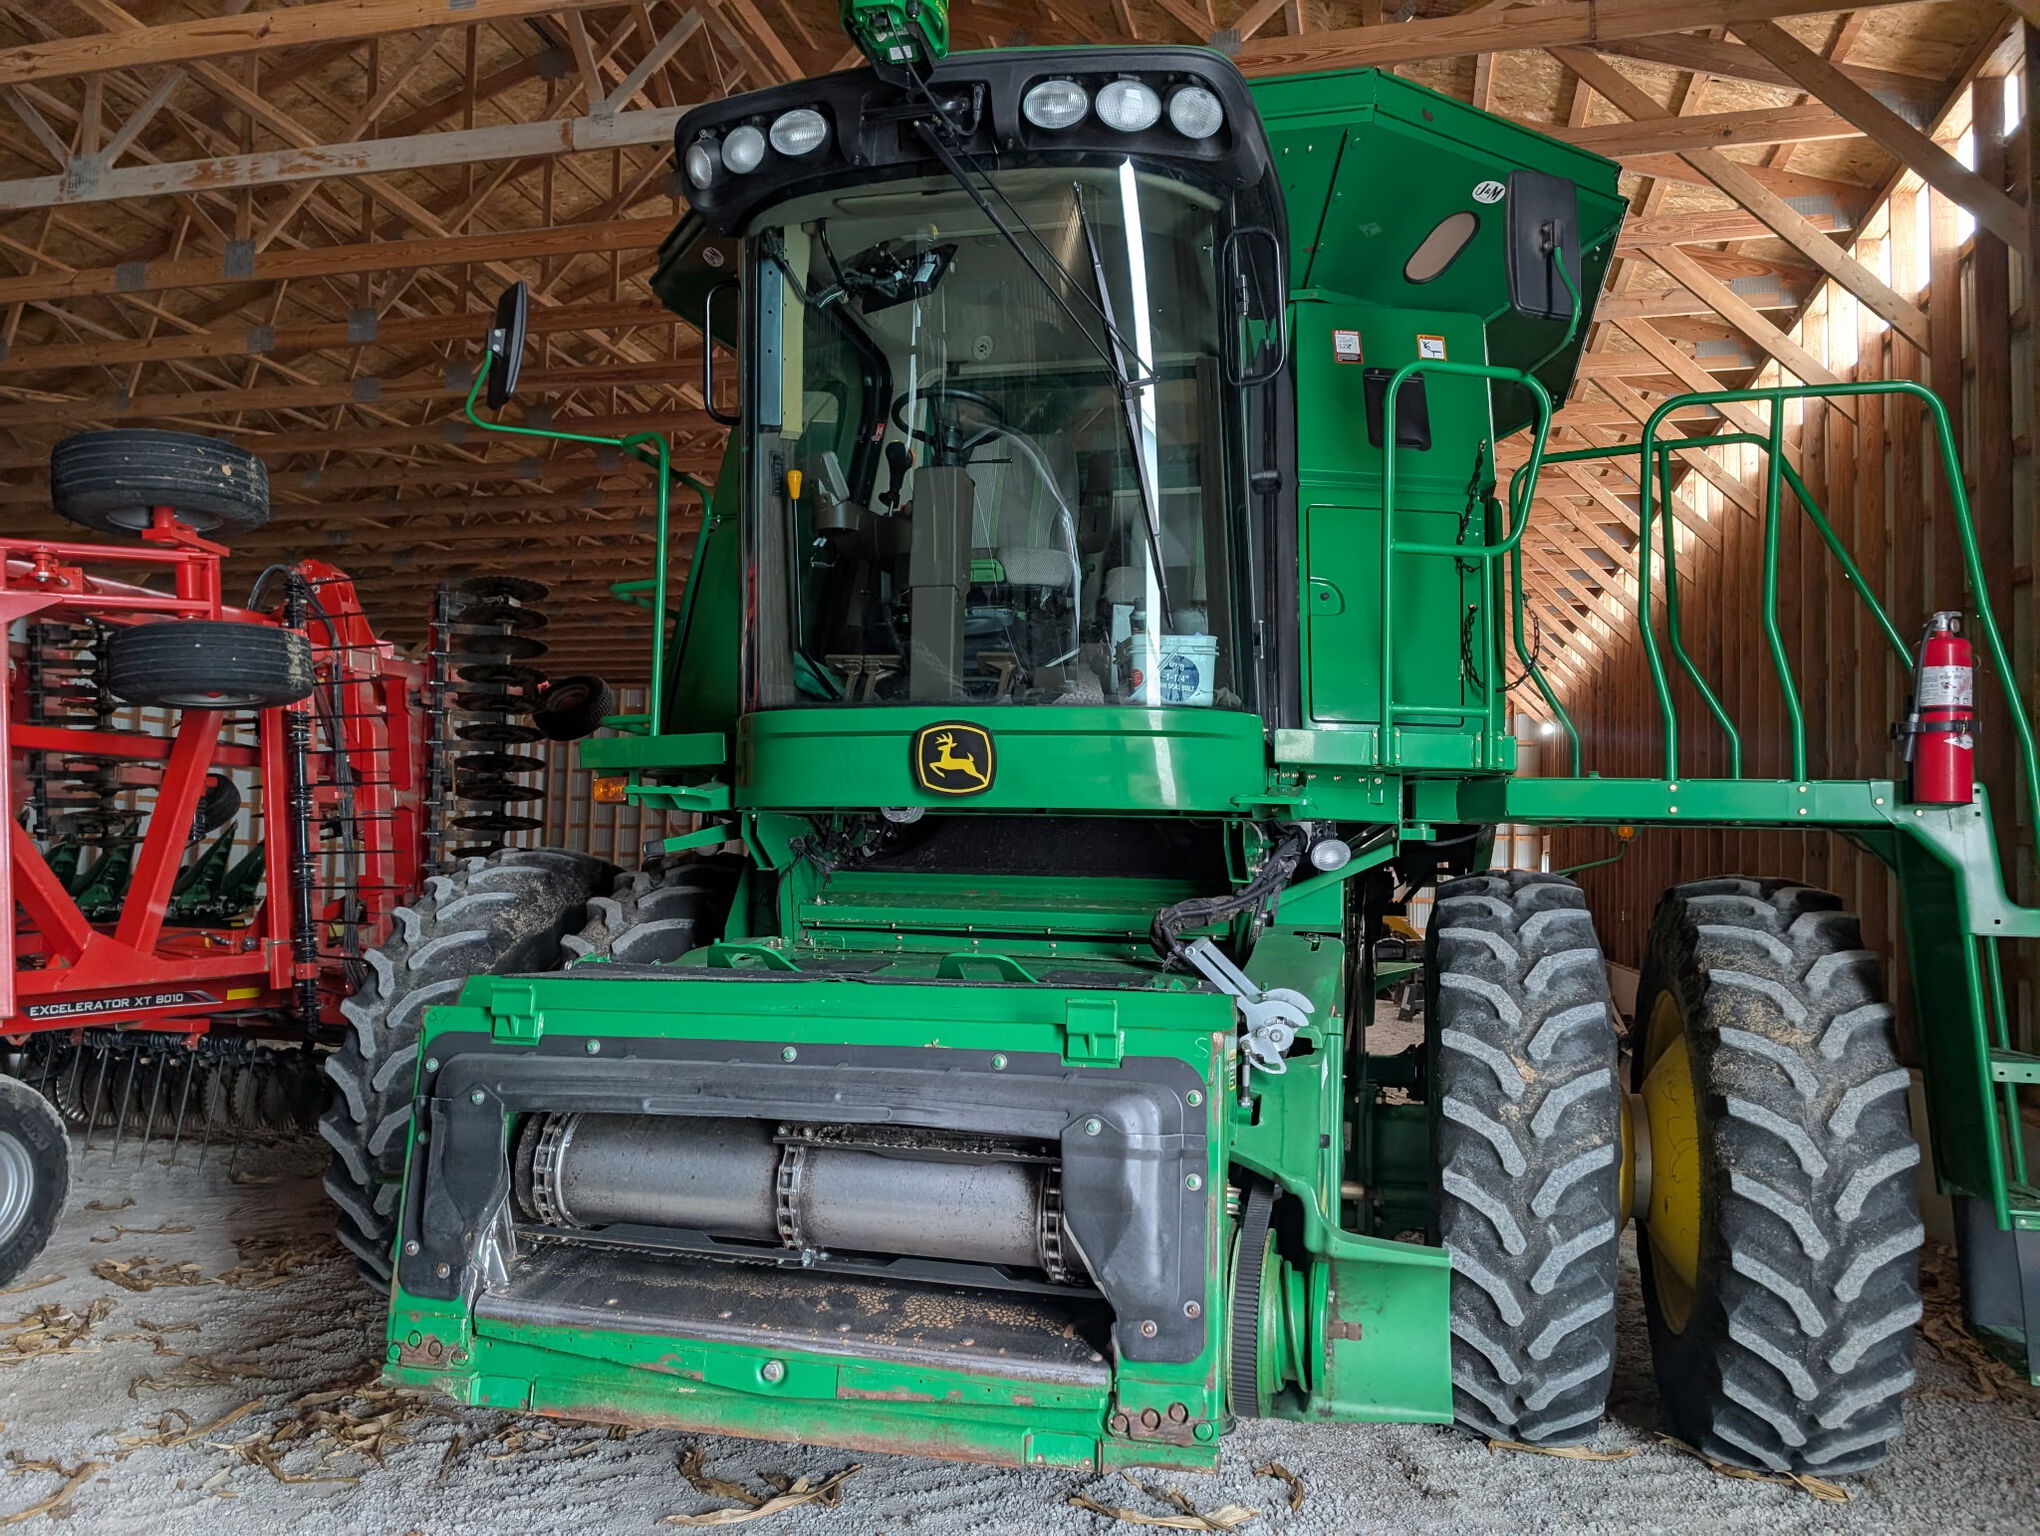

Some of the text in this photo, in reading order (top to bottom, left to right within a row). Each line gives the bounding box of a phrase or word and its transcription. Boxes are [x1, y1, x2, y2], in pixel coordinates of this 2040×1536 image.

[1475, 183, 1504, 200] J&M
[30, 993, 184, 1017] EXCELERATOR XT 8010
